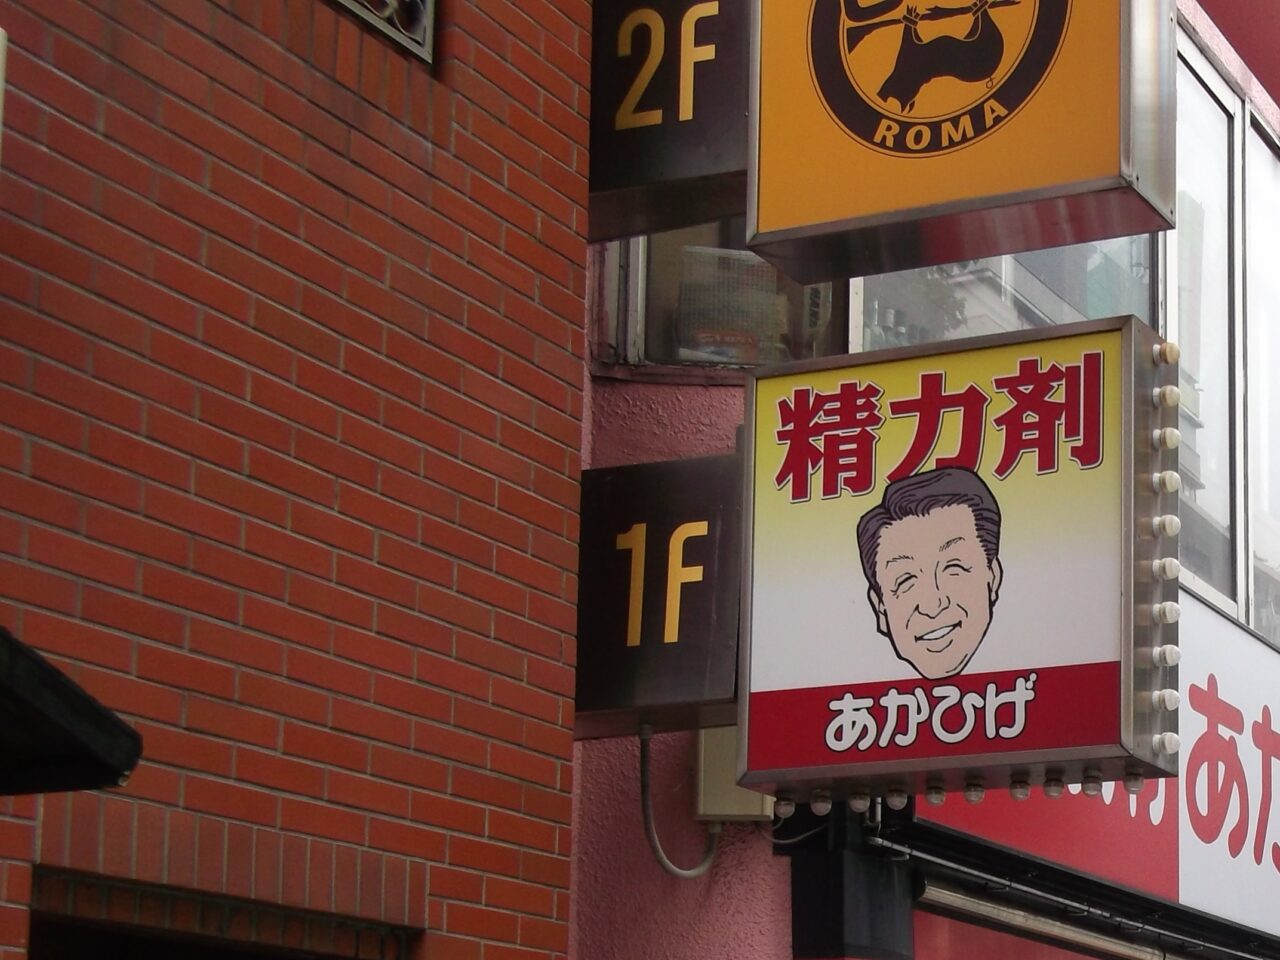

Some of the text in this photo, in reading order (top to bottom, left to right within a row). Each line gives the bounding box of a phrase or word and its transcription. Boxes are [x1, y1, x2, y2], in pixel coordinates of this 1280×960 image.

[615, 1, 719, 131] 2F
[873, 98, 1009, 150] ROMA
[776, 352, 1105, 502] 精力剤
[616, 521, 709, 647] 1F
[825, 672, 1036, 752] あかひげ
